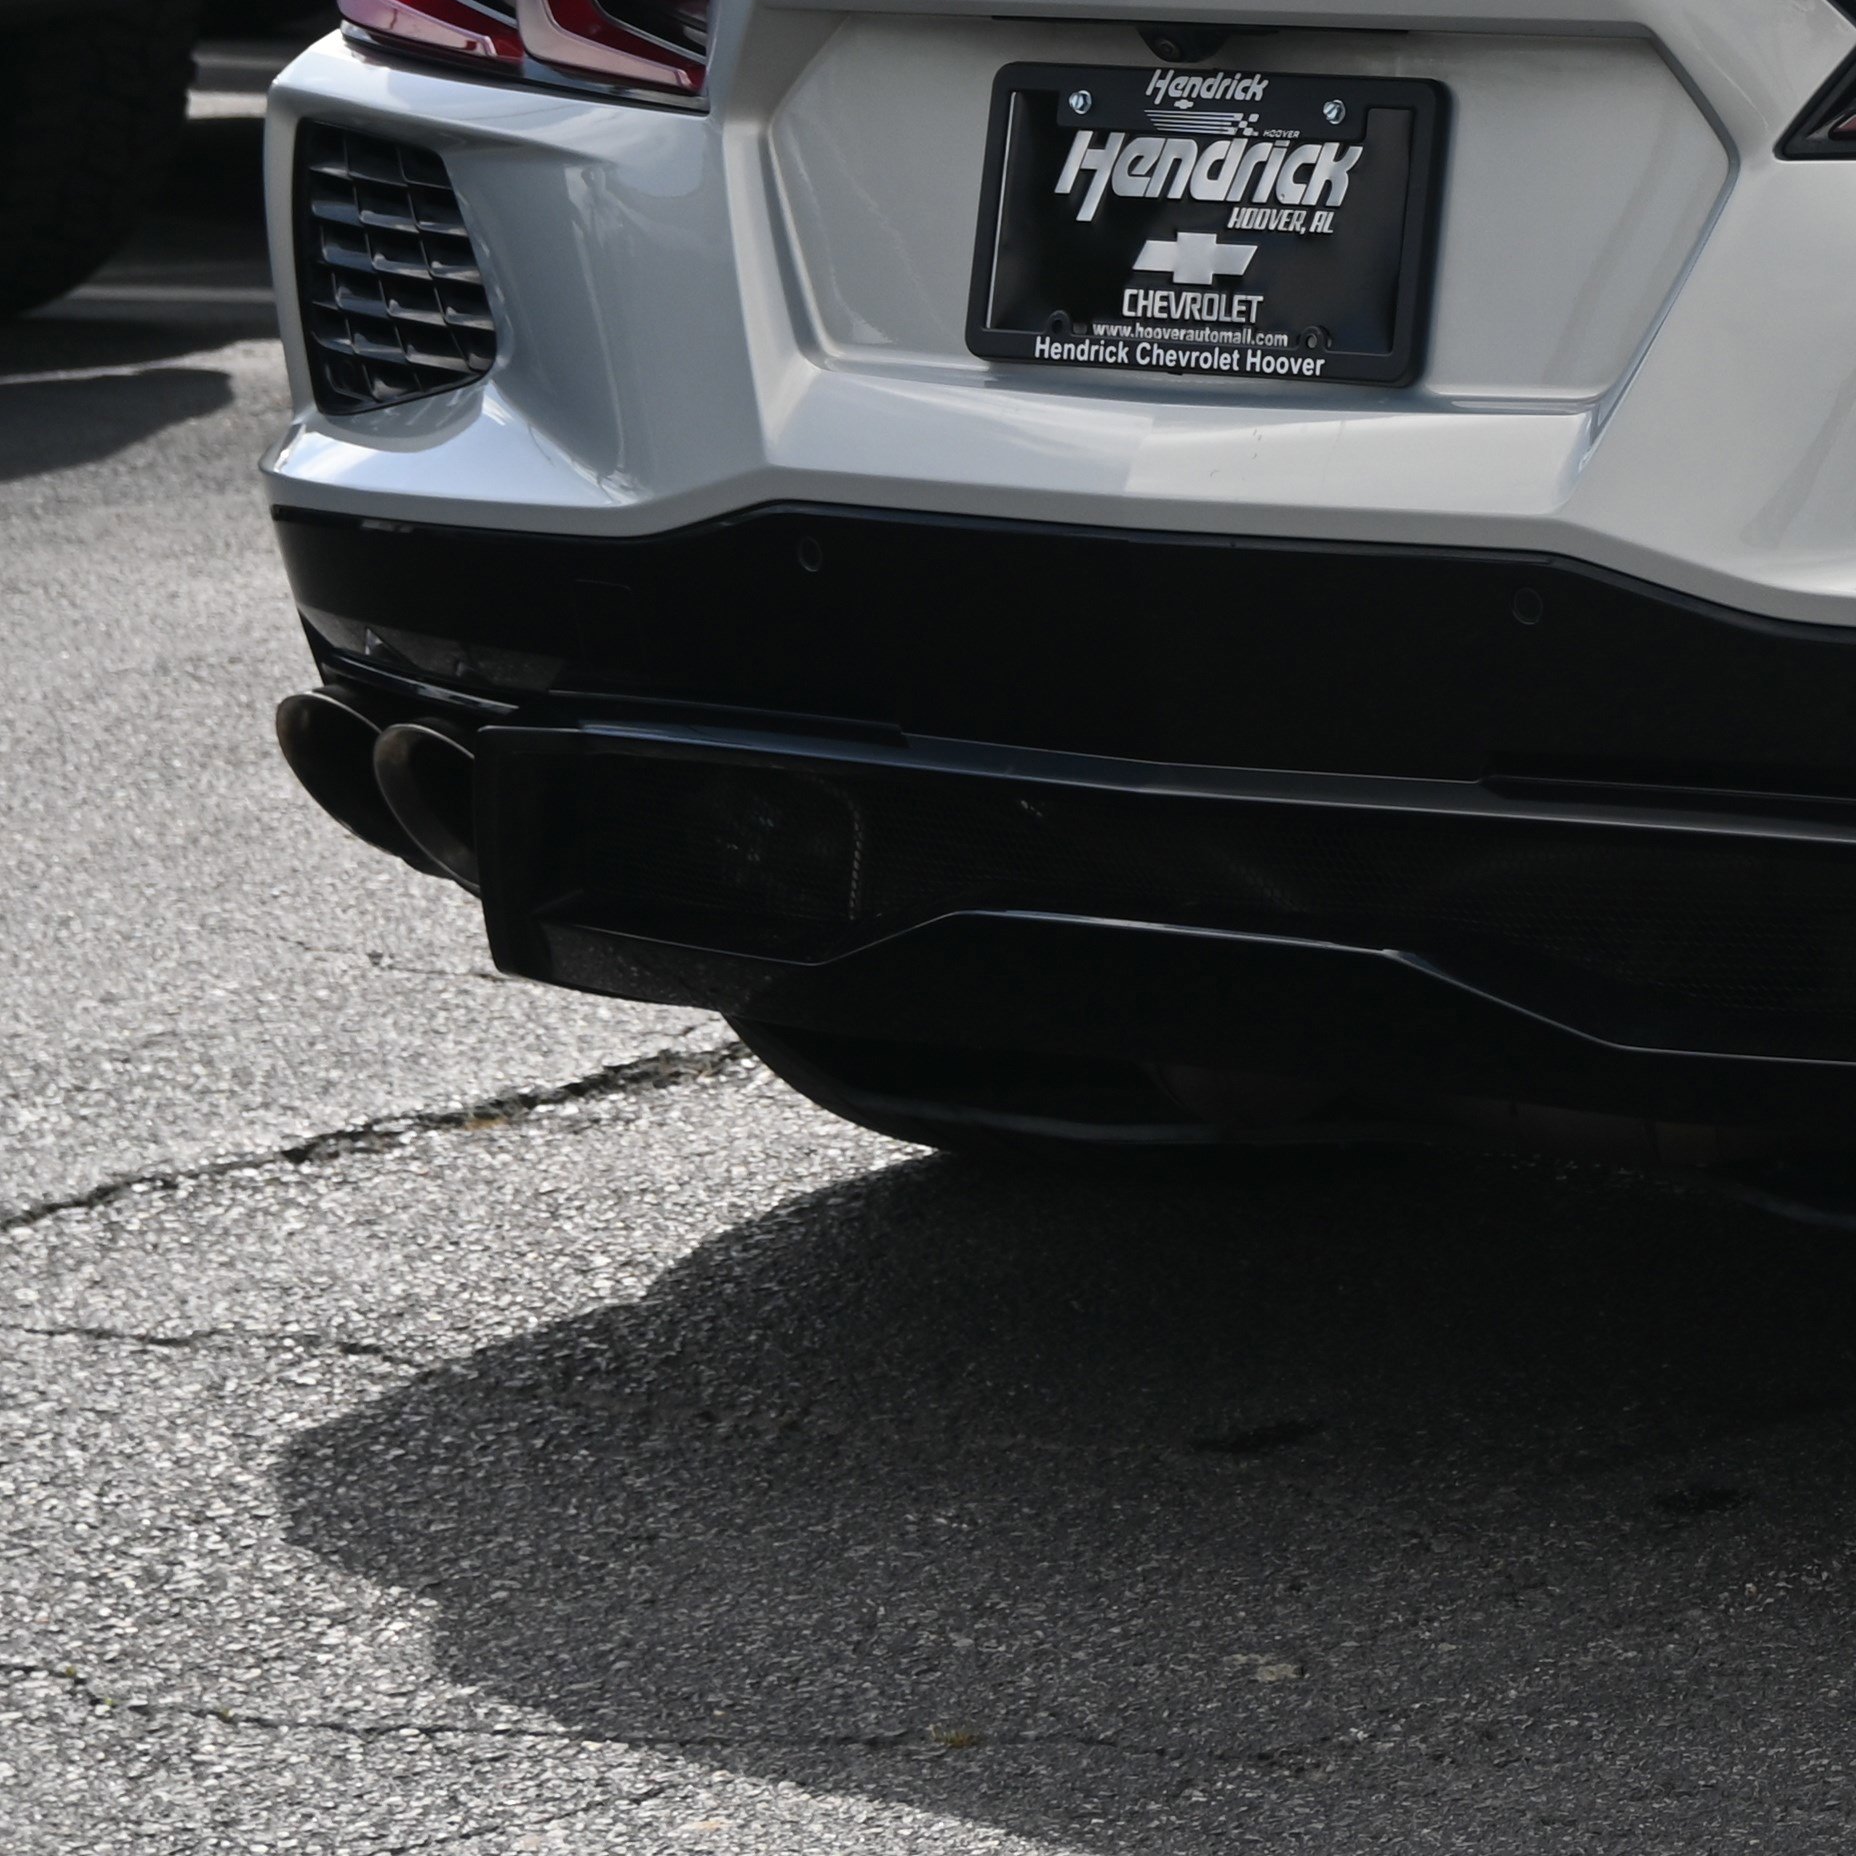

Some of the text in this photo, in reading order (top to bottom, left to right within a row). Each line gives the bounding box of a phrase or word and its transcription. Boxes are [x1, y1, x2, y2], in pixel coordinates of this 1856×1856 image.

[1145, 69, 1269, 105] Hendrick
[1262, 129, 1300, 139] HOOVER
[1054, 130, 1363, 222] Hendrick
[1227, 206, 1334, 234] HOOVER, AL
[1122, 288, 1264, 324] CHEVROLET
[1092, 321, 1289, 347] www.hooverautomall.com
[1034, 335, 1325, 376] Hendrick Chevrolet Hoover
